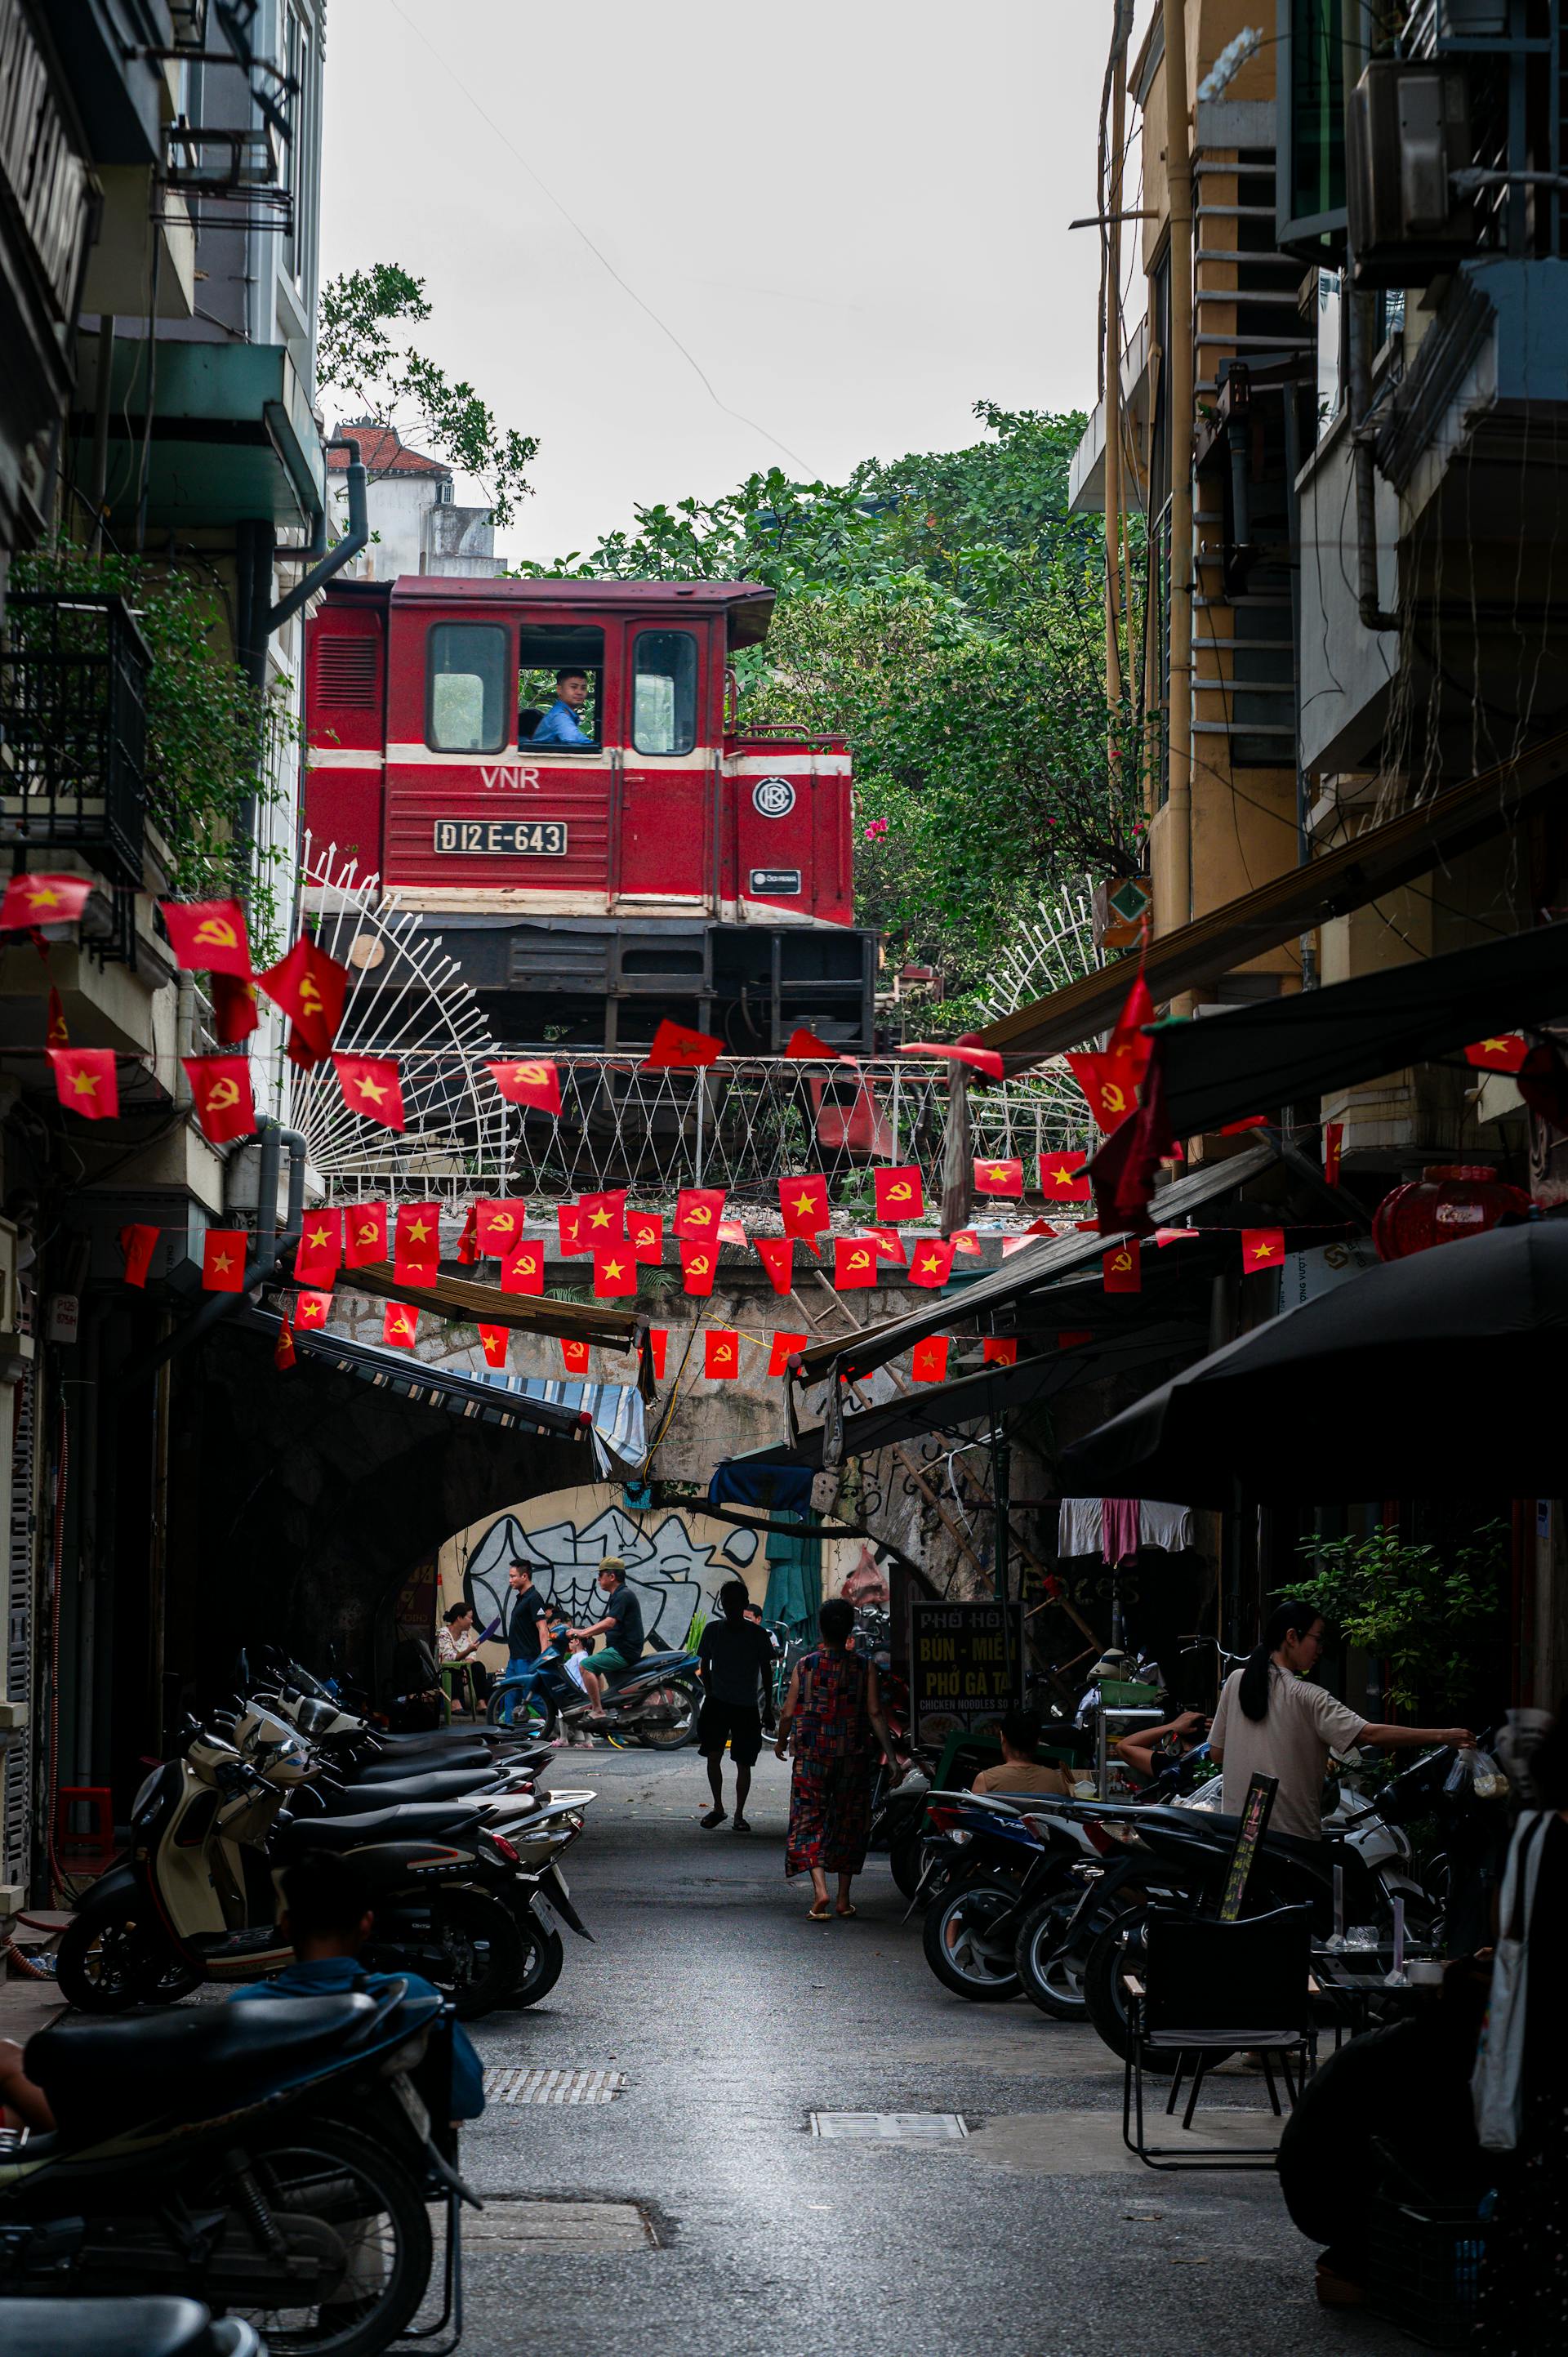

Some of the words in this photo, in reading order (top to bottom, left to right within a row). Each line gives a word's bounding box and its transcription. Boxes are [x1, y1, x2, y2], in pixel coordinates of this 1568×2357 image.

[479, 767, 541, 790] VNR
[919, 1633, 955, 1661] BÚN
[926, 1664, 961, 1696] PHỞ
[964, 1667, 987, 1695] GÀ
[920, 1699, 956, 1711] CHICKEN
[957, 1699, 996, 1711] NOODLES
[996, 1699, 1020, 1710] SOP
